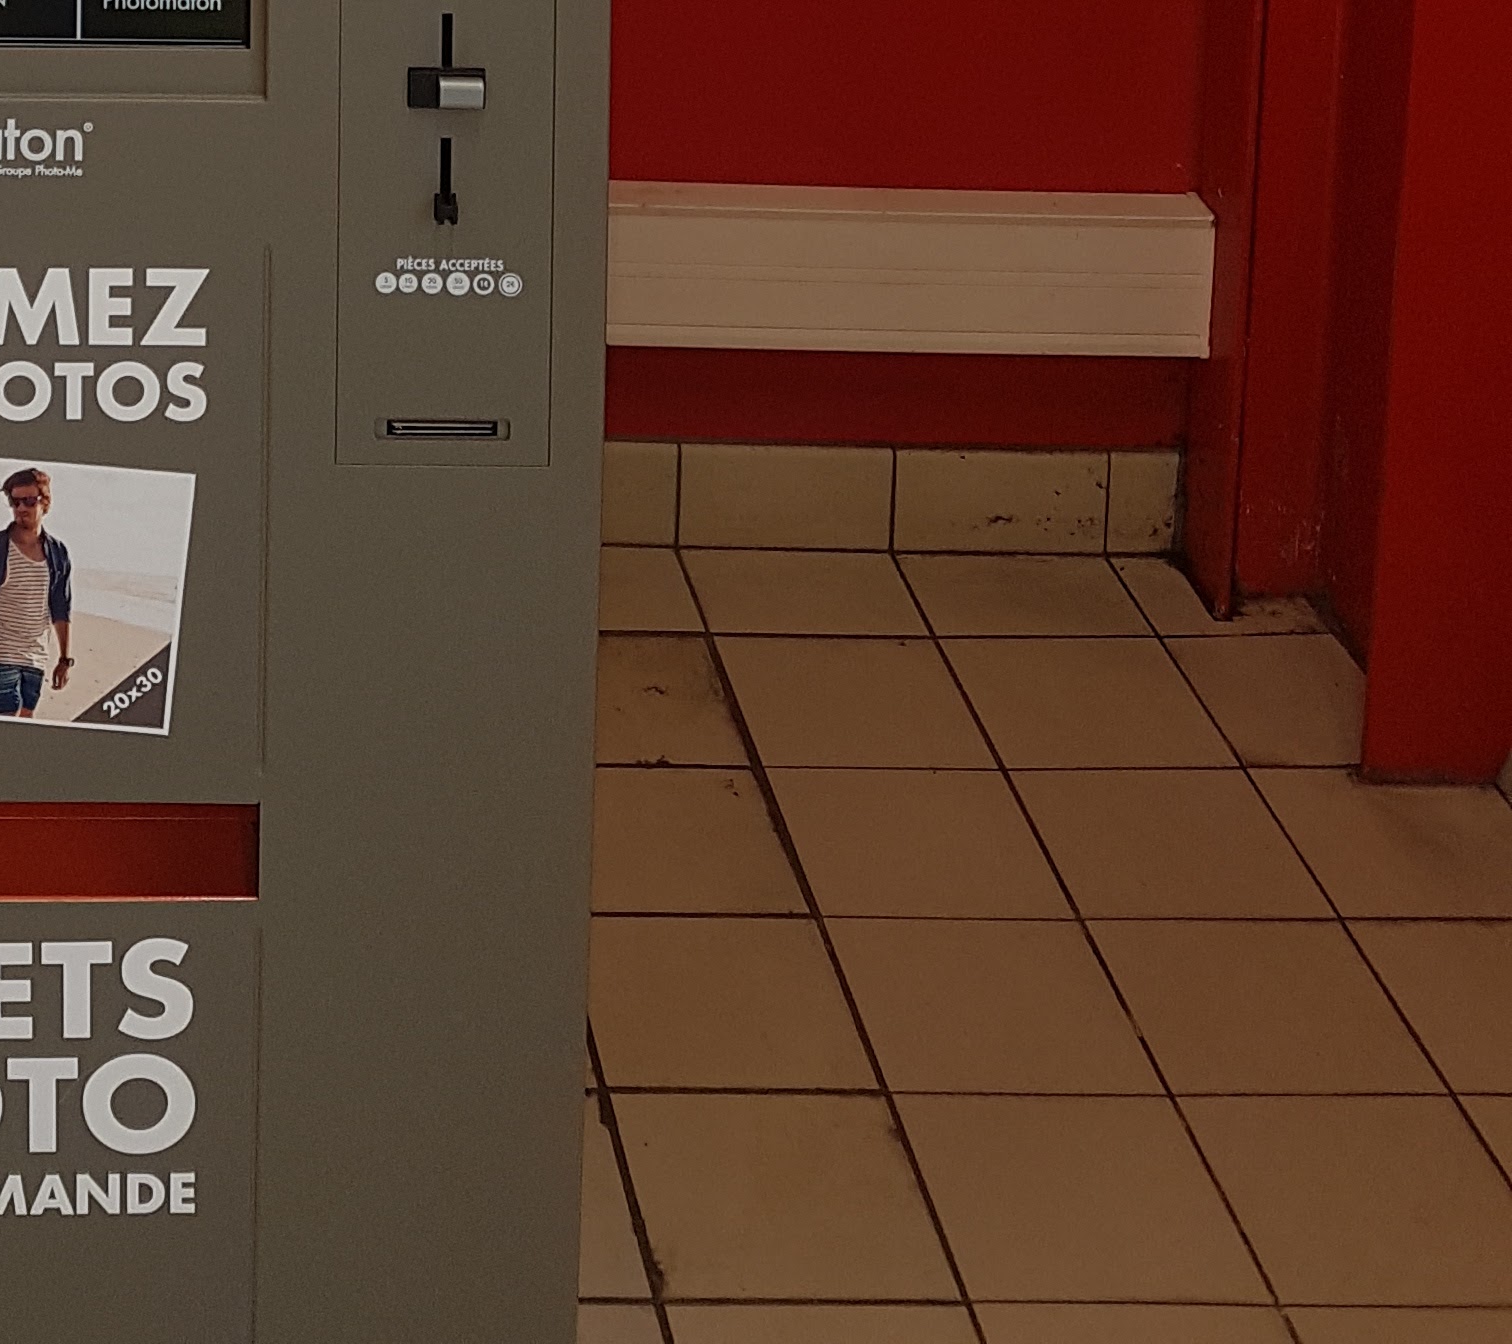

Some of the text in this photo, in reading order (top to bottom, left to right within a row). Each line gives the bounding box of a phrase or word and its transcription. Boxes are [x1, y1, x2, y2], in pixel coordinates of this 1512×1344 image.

[35, 165, 83, 177] Photo-Me
[396, 256, 504, 271] PIÈCES ACCEPTÉES
[102, 667, 163, 719] 20x30
